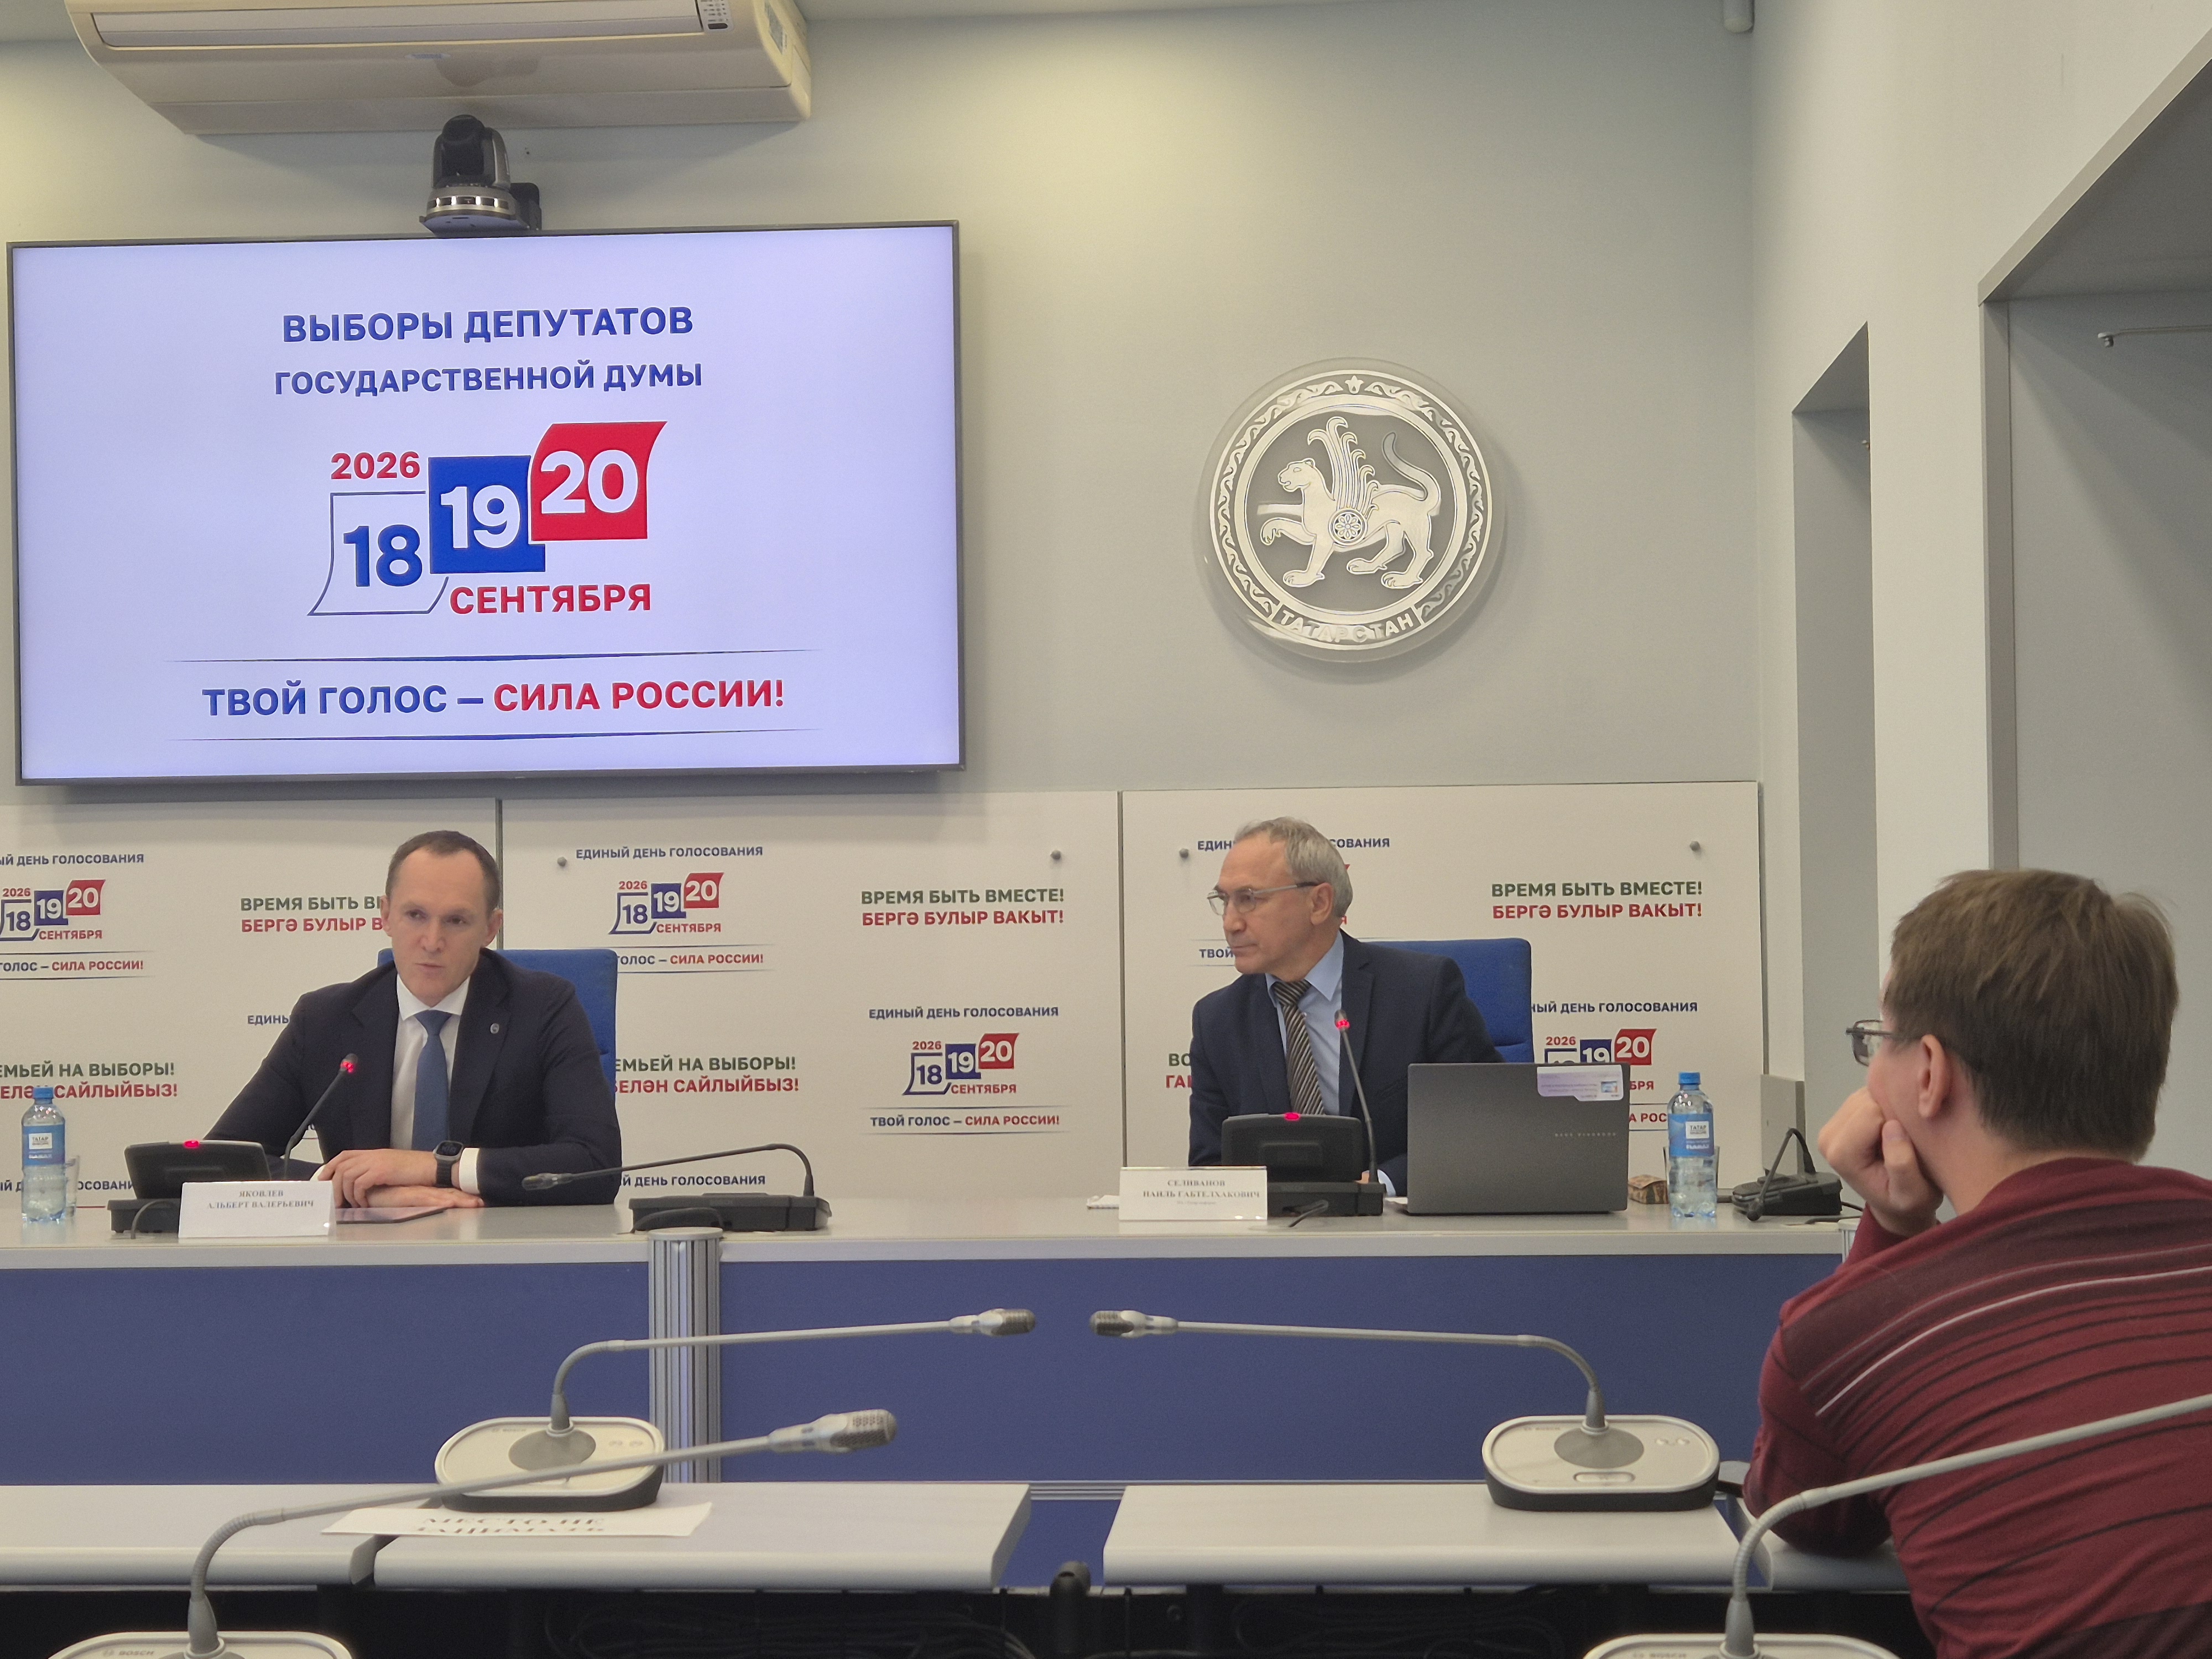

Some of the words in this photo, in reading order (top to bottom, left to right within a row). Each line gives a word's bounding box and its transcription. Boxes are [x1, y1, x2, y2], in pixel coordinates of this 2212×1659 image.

[284, 312, 452, 342] ВЫБОРЫ
[464, 307, 692, 343] ДЕПУТАТОВ
[275, 359, 594, 397] ГОСУДАРСТВЕННОЙ
[604, 363, 701, 392] ДУМЫ
[331, 451, 420, 479] 2026
[343, 524, 422, 587] 18
[441, 485, 520, 549] 19
[541, 450, 638, 514] 20
[450, 583, 651, 614] СЕНТЯБРЯ
[1280, 611, 1414, 643] ТАТАРСТАН
[202, 680, 305, 716] ТВОЙ
[319, 685, 446, 714] ГОЛОС
[494, 684, 600, 712] СИЛА
[612, 680, 783, 709] РОССИИ!
[576, 847, 629, 860] ЕДИНЫЙ
[633, 848, 666, 859] ДЕНЬ
[670, 847, 763, 857] ГОЛОСОВАНИЯ
[1198, 841, 1235, 852] ЕДИН
[17, 856, 49, 866] ДЕНЬ
[53, 854, 144, 864] ГОЛОСОВАНИЯ
[3, 888, 30, 897] 2026
[619, 881, 647, 890] 2026
[1492, 883, 1556, 896] ВРЕМЯ
[1562, 883, 1614, 896] БЫТЬ
[1620, 881, 1702, 895] ВМЕСТЕ!
[623, 904, 648, 924] 18
[654, 891, 679, 912] 19
[686, 880, 717, 901] 20
[862, 891, 923, 904] ВРЕМЯ
[930, 890, 980, 903] БЫТЬ
[985, 889, 1063, 902] ВМЕСТЕ!
[6, 911, 30, 931] 18
[36, 898, 61, 919] 19
[67, 888, 98, 908] 20
[241, 898, 302, 911] ВРЕМЯ
[309, 897, 358, 910] БЫТЬ
[1493, 905, 1551, 919] БЕРГӘ
[1557, 904, 1623, 918] БУЛЫР
[1629, 903, 1701, 917] ВАКЫТ!
[242, 919, 298, 932] БЕРГӘ
[304, 918, 366, 931] БУЛЫР
[863, 912, 919, 926] БЕРГӘ
[925, 911, 988, 925] БУЛЫР
[994, 910, 1063, 924] ВАКЫТ!
[39, 930, 102, 940] СЕНТЯБРЯ
[656, 923, 721, 933] СЕНТЯБРЯ
[52, 962, 85, 971] СИЛА
[89, 961, 143, 970] РОССИИ!
[670, 955, 704, 964] СИЛА
[708, 954, 763, 963] РОССИИ!
[869, 1006, 923, 1020] ЕДИНЫЙ
[926, 1008, 960, 1019] ДЕНЬ
[964, 1007, 1058, 1017] ГОЛОСОВАНИЯ
[1561, 1003, 1595, 1014] ДЕНЬ
[1599, 1002, 1697, 1012] ГОЛОСОВАНИЯ
[913, 1041, 941, 1050] 2026
[1546, 1036, 1576, 1045] 2026
[1583, 1048, 1610, 1063] 19
[1616, 1036, 1650, 1058] 20
[679, 1058, 703, 1071] НА
[709, 1057, 795, 1070] ВЫБОРЫ!
[916, 1065, 942, 1084] 18
[948, 1050, 975, 1073] 19
[980, 1041, 1013, 1062] 20
[59, 1064, 84, 1077] НА
[90, 1063, 174, 1076] ВЫБОРЫ!
[54, 1081, 177, 1098] САЙЛЫЙБЫЗ!
[674, 1075, 799, 1092] САЙЛЫЙБЫЗ!
[951, 1084, 1016, 1094] СЕНТЯБРЯ
[870, 1115, 904, 1126] ТВОЙ
[909, 1117, 950, 1126] ГОЛОС
[966, 1116, 1000, 1125] СИЛА
[1004, 1115, 1059, 1125] РОССИИ!
[634, 1177, 667, 1187] ДЕНЬ
[672, 1176, 765, 1185] ГОЛОСОВАНИЯ
